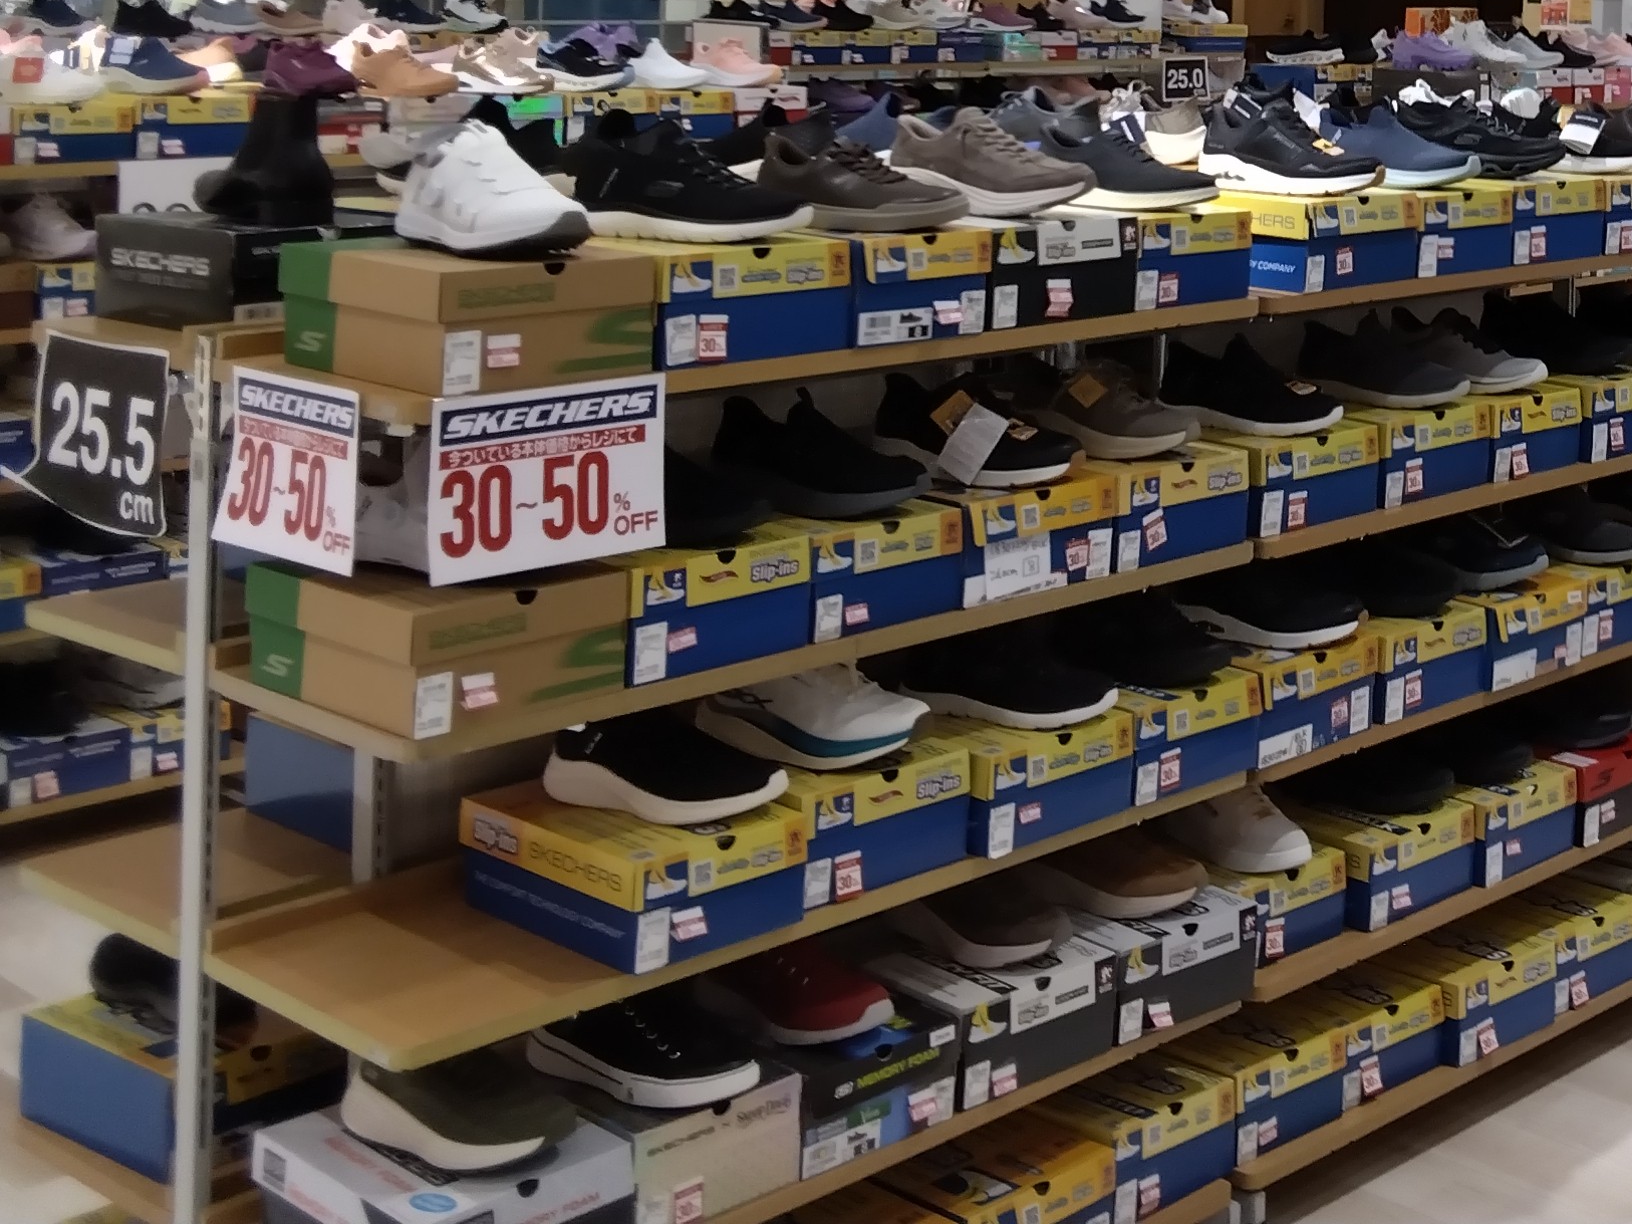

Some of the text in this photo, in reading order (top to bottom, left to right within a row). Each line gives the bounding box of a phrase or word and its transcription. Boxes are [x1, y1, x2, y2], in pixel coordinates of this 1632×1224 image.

[1166, 68, 1204, 90] 25.0
[1250, 214, 1296, 230] HERS
[110, 247, 210, 276] SKECHERS
[240, 384, 355, 430] SKECHERS
[444, 391, 655, 440] SKECHERS
[49, 381, 156, 486] 25.5
[450, 427, 637, 467] 今ついている本体価格からレジにて
[119, 490, 155, 525] cm
[613, 510, 659, 536] OFF
[322, 531, 351, 556] OFF
[750, 559, 800, 583] Slip-ins
[916, 774, 962, 799] Slip-ins
[529, 841, 623, 892] SKECHERS
